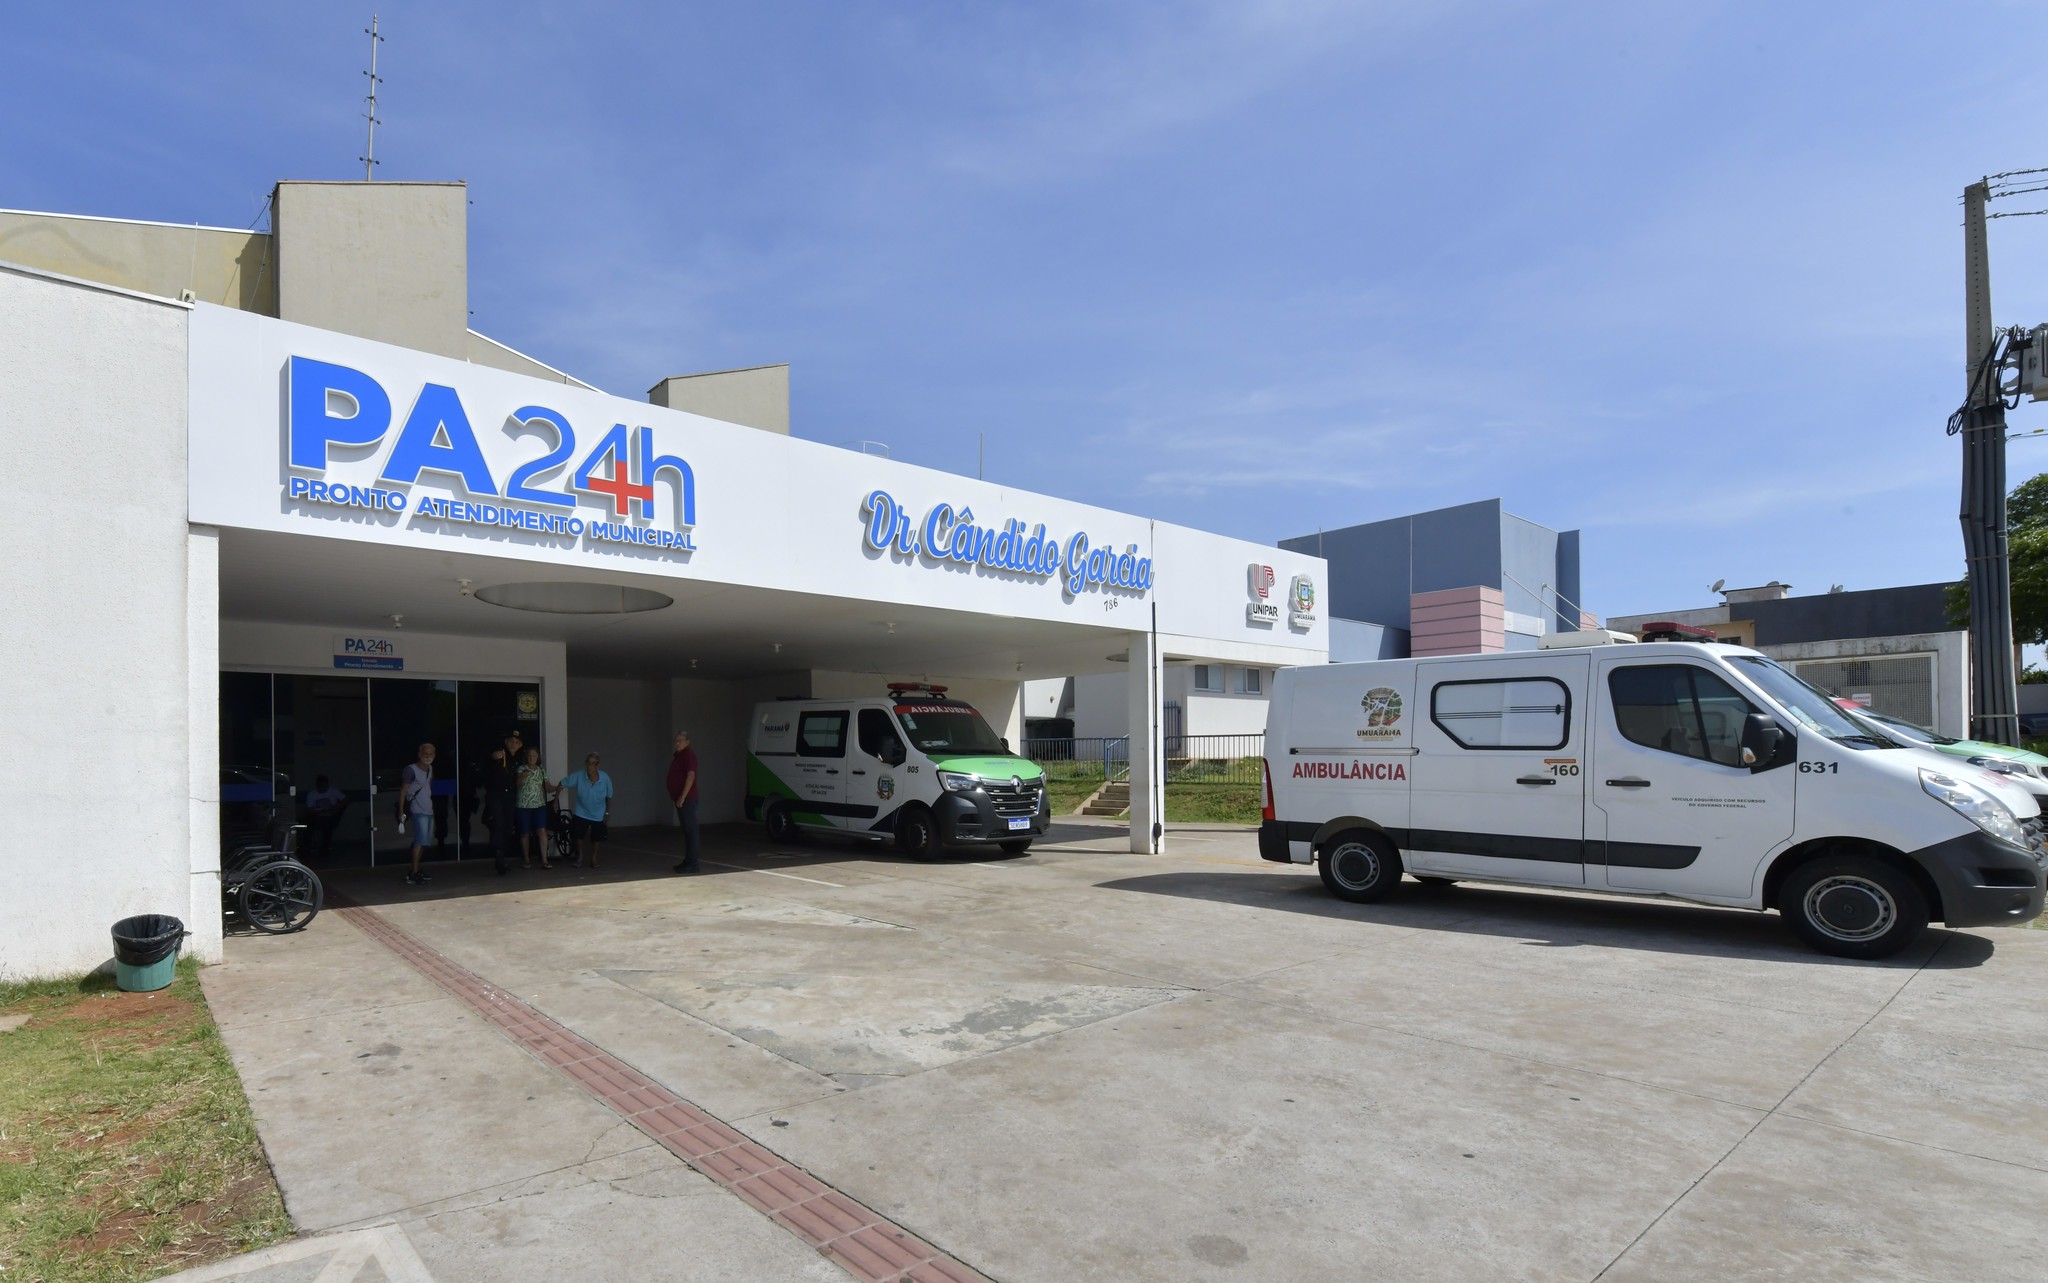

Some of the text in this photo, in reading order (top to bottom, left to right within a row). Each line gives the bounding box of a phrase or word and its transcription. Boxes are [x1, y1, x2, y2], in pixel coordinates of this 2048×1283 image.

[289, 476, 698, 551] PRONTO ATENDIMENTO MUNICIPAL
[1064, 530, 1155, 597] Garcia
[1103, 597, 1119, 612] 786
[1252, 603, 1279, 618] UNIPAR
[1356, 729, 1402, 737] UMUARAMA
[907, 765, 919, 774] 805
[1292, 760, 1407, 781] AMBULÂNCIA
[1550, 764, 1580, 777] 160
[1798, 761, 1839, 774] 631
